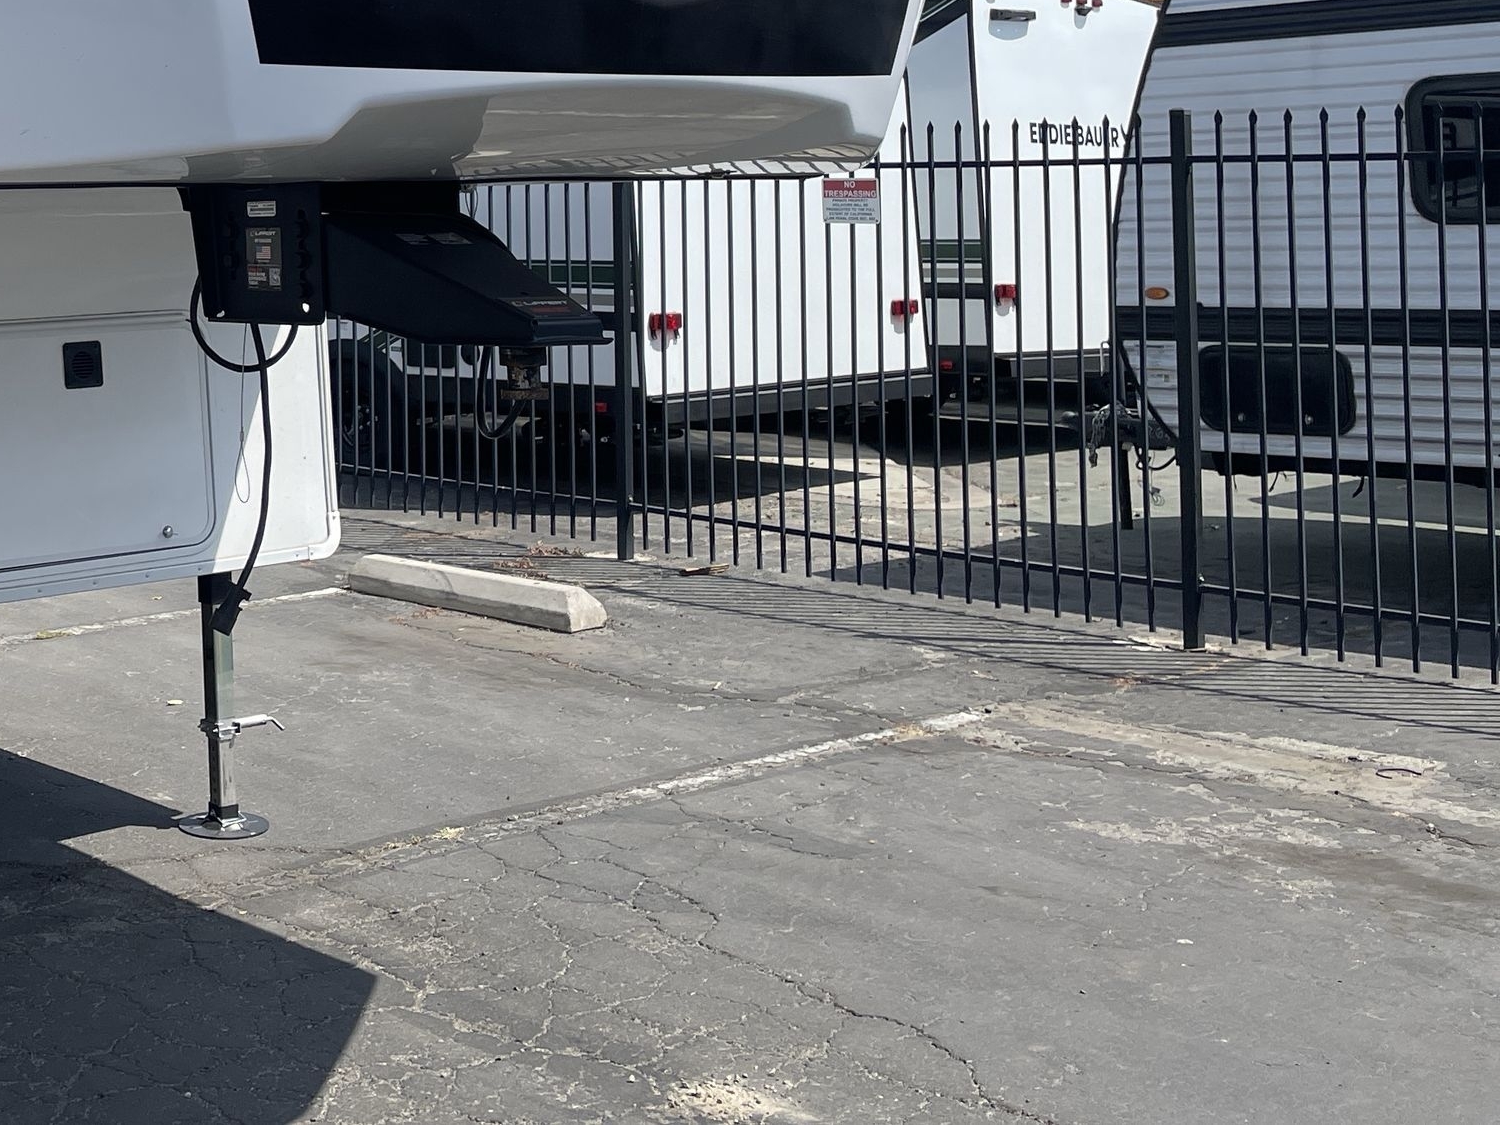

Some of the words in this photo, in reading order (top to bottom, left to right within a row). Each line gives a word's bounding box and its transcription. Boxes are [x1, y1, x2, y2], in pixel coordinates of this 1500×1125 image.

[1075, 125, 1119, 148] BAUR
[843, 180, 856, 188] NO
[824, 190, 877, 198] TRESPASSING
